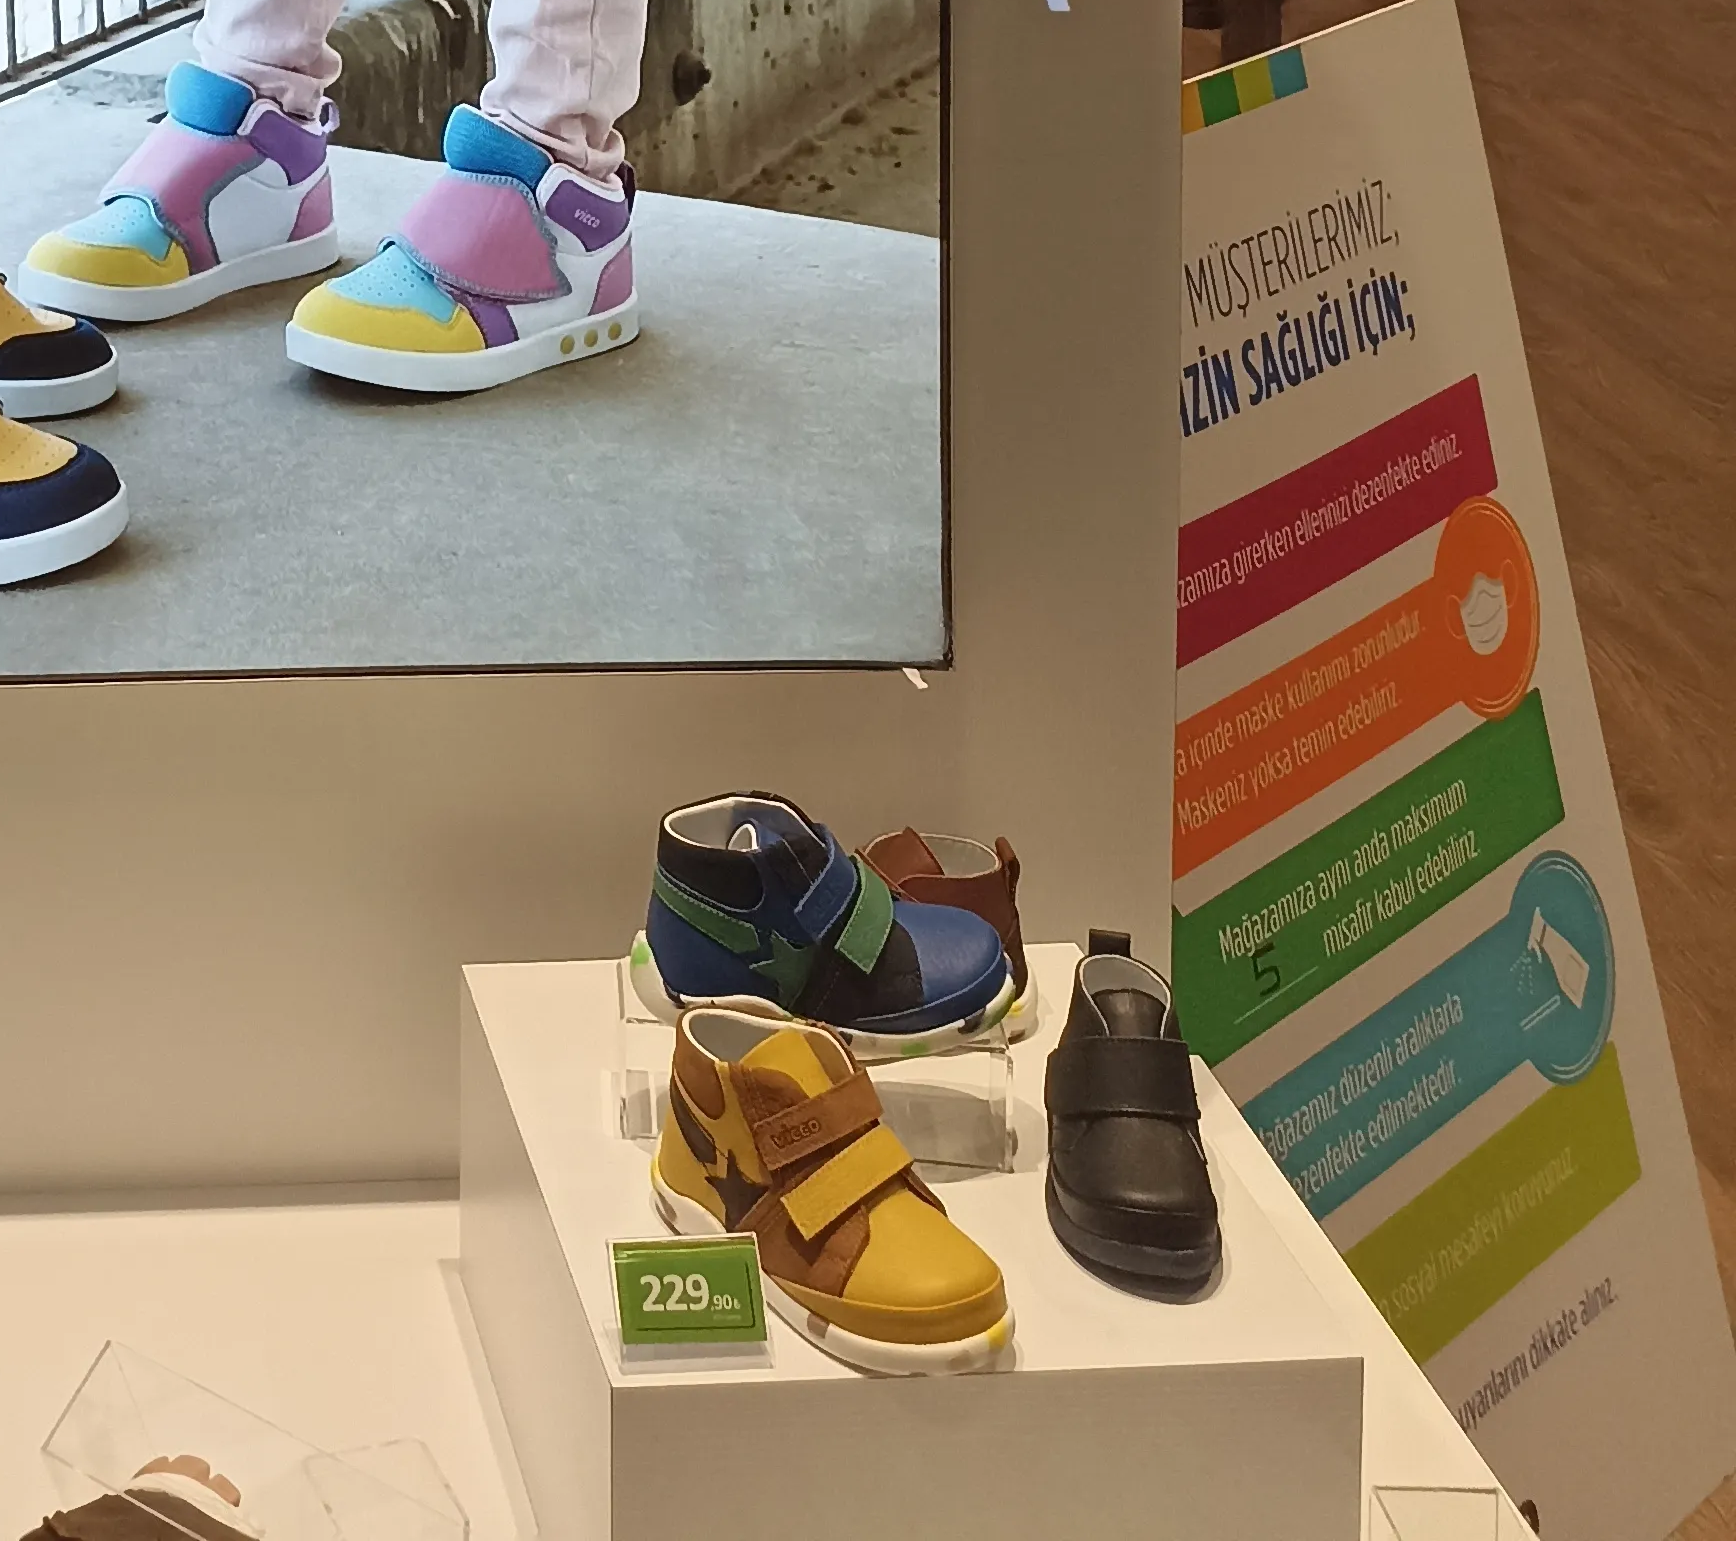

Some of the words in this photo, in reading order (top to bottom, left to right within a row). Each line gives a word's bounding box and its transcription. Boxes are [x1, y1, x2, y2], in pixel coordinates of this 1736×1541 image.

[1184, 178, 1400, 328] MÜŞTERİLERİMİZ;
[1241, 290, 1351, 406] SAĞLIĞI
[1346, 268, 1416, 356] İÇİN;
[1232, 526, 1294, 585] girerken
[1351, 454, 1422, 515] dezenfekte
[1177, 769, 1249, 835] Maskeniz
[1248, 747, 1293, 799] yoksa
[1292, 717, 1338, 767] temin
[1235, 691, 1285, 742] maske
[1218, 880, 1317, 965] Mağazamıza
[1317, 857, 1352, 900] aynı
[1352, 828, 1391, 878] anda
[1390, 779, 1468, 851] maksimum
[1250, 941, 1282, 997] 5
[1322, 897, 1374, 958] misafir
[1373, 866, 1417, 922] kabul
[1338, 1038, 1394, 1107] düzenli
[1287, 1128, 1368, 1201] ezenfekte
